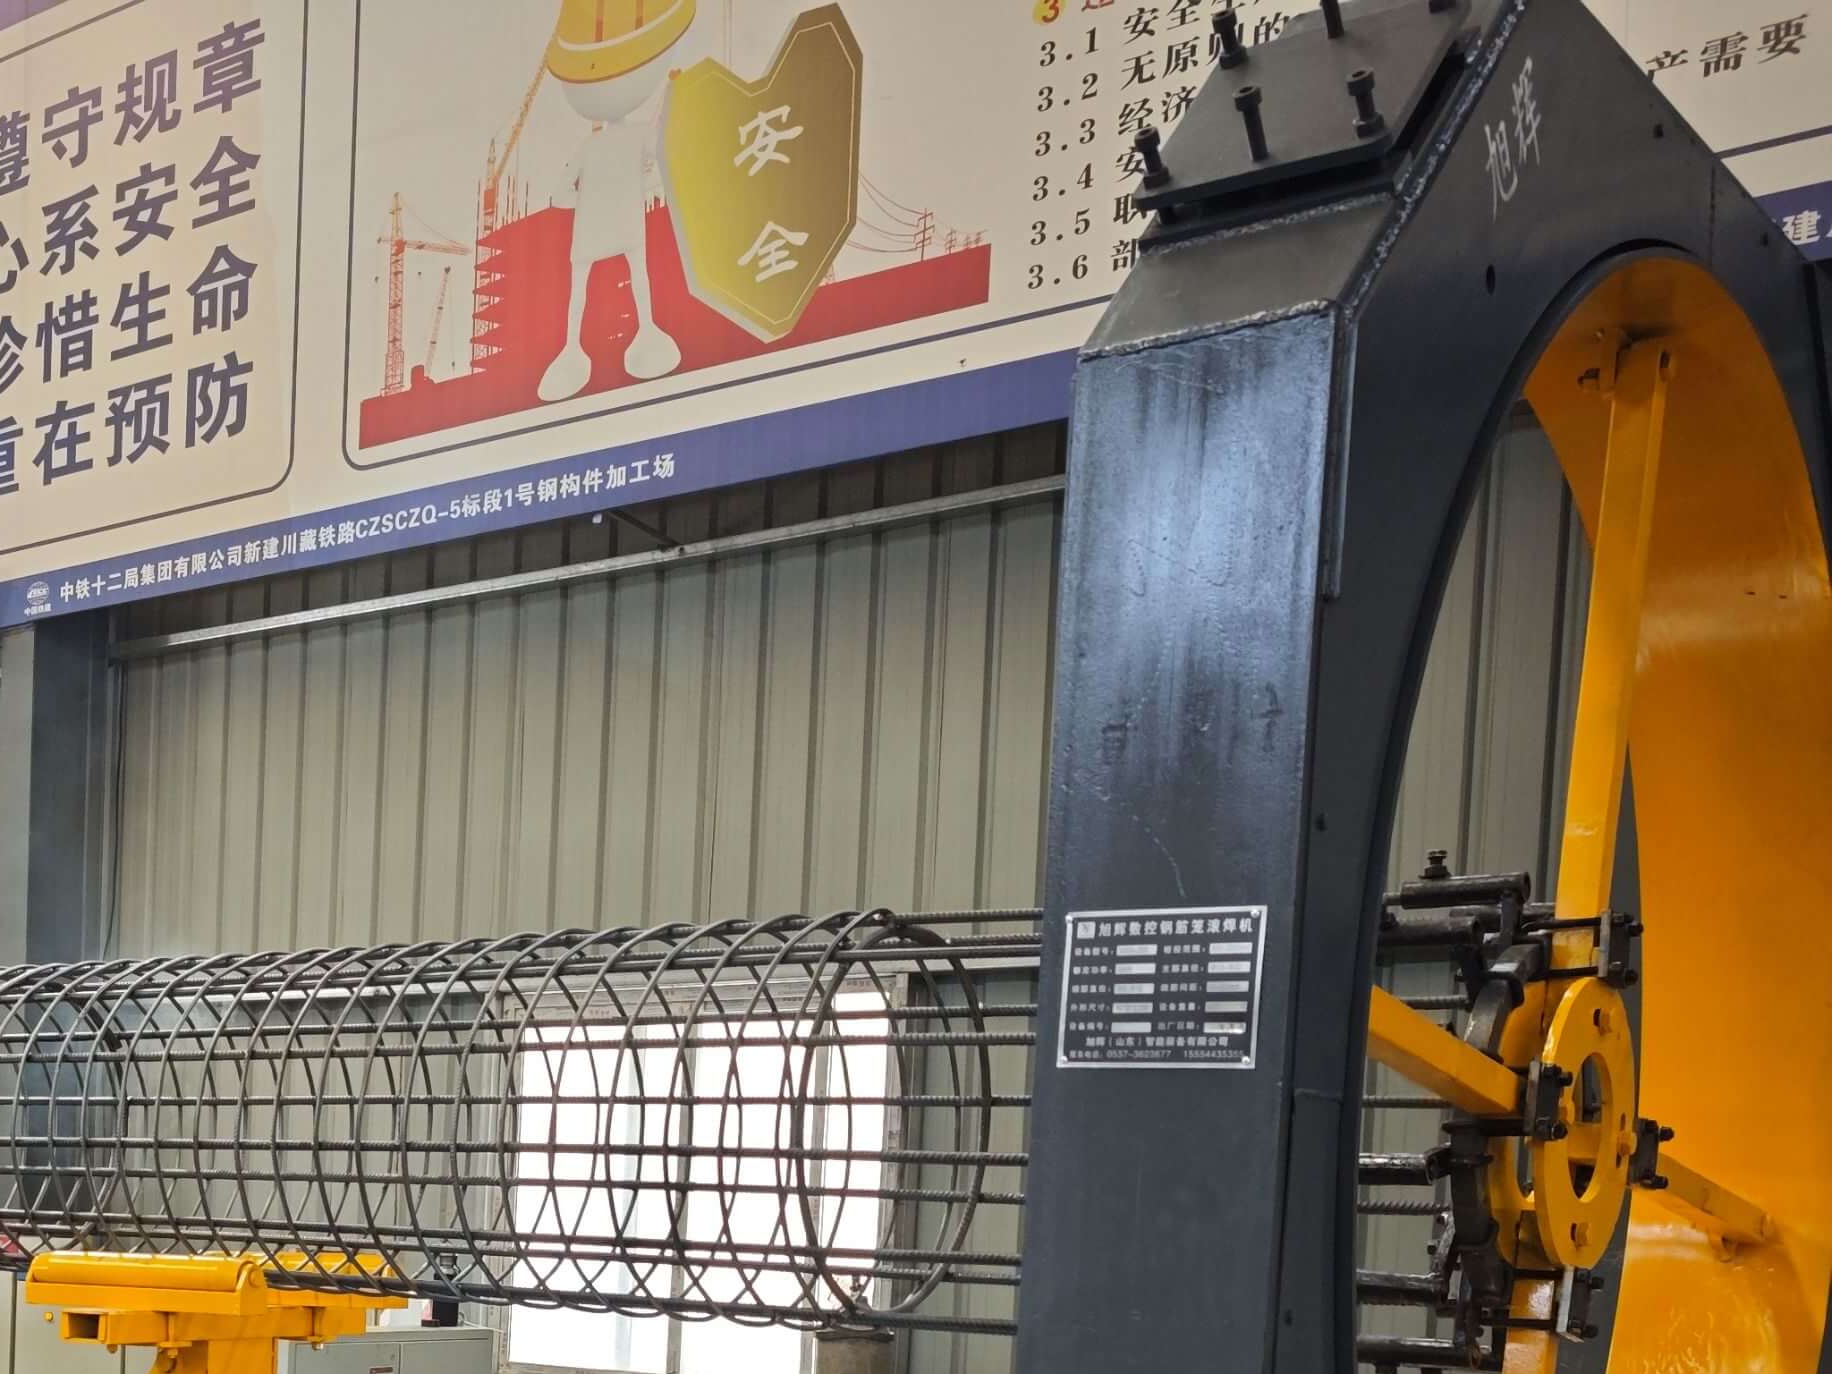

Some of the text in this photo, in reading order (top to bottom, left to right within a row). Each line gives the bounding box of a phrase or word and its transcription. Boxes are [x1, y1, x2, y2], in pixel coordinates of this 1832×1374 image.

[1039, 27, 1100, 67] 3.1
[1037, 73, 1099, 113] 3.2
[1034, 118, 1097, 157] 3.3
[733, 104, 809, 284] 安全
[1032, 162, 1095, 202] 3.4
[1029, 207, 1092, 247] 3.5
[1782, 209, 1832, 246] 建
[1027, 254, 1089, 290] 3.6
